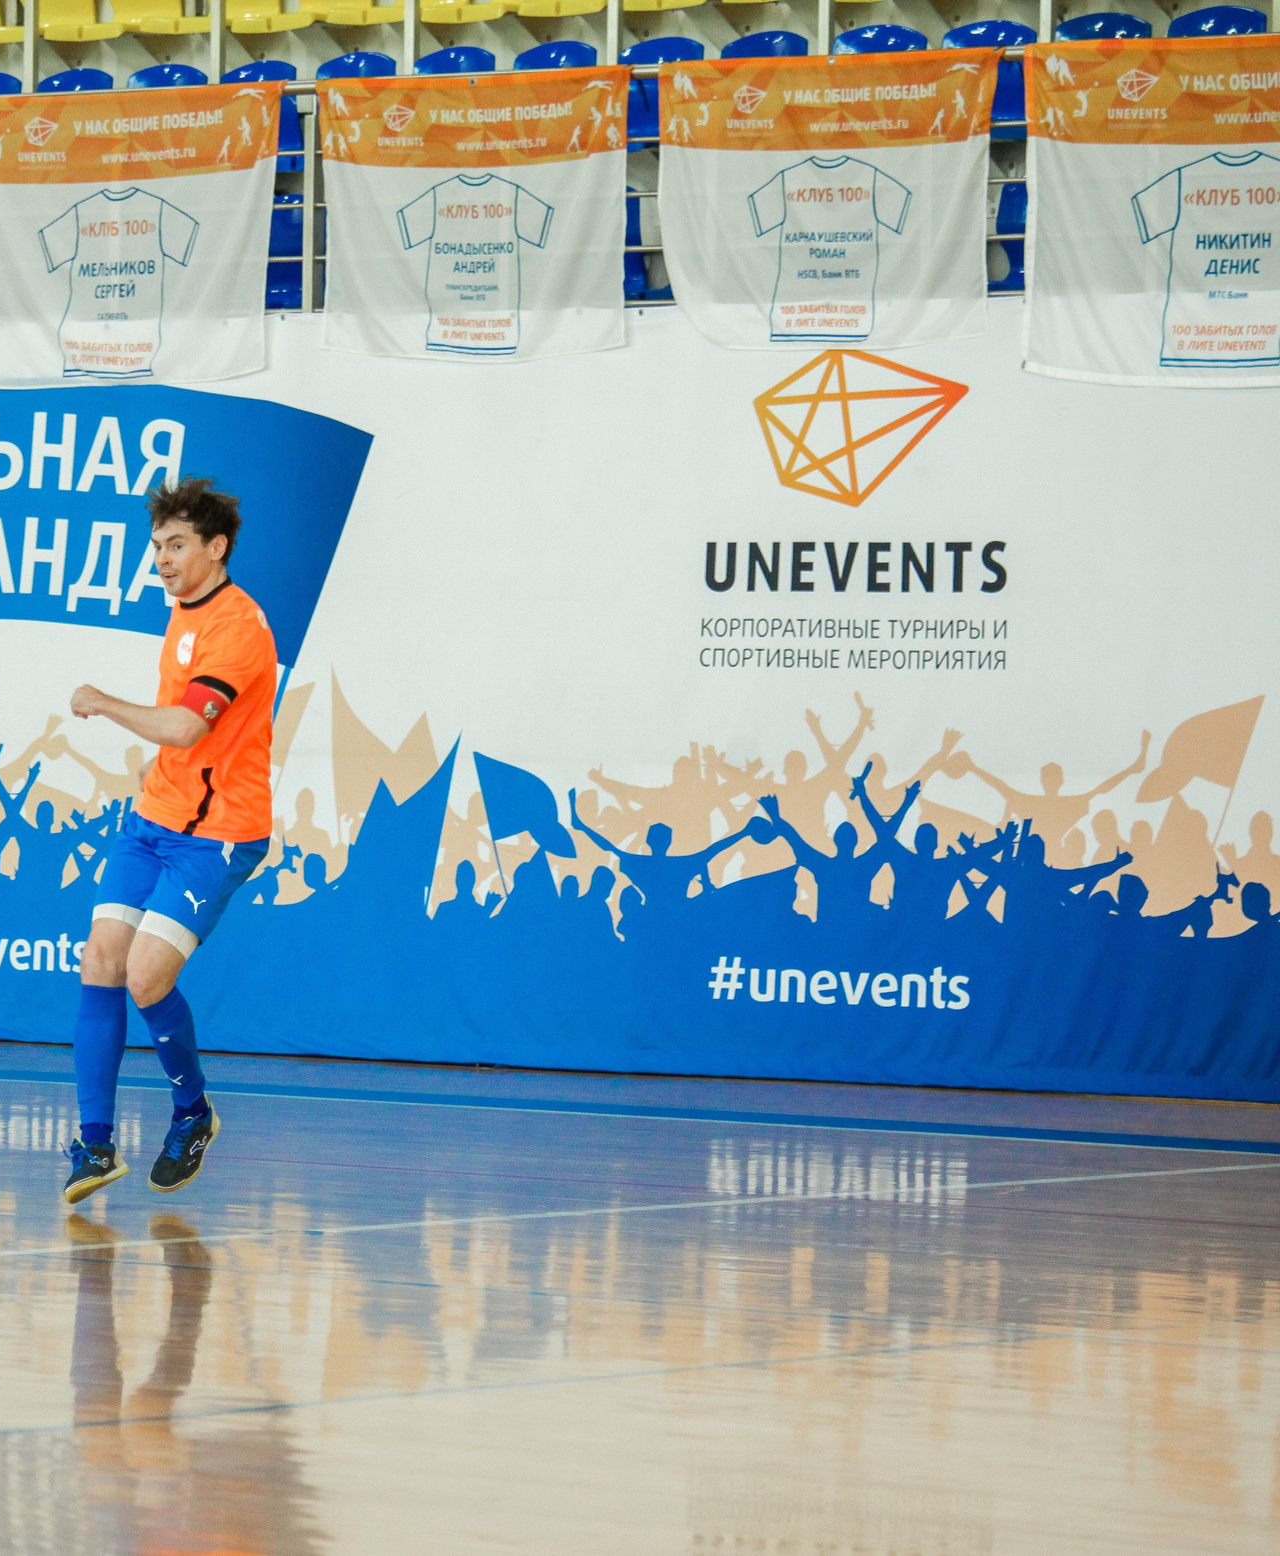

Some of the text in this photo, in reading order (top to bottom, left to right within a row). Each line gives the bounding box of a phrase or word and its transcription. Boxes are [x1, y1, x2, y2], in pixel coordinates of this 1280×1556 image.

[1179, 72, 1280, 92] У НАС ОБЩИ
[783, 82, 936, 104] У НАС ОБЩИЕ ПОБЕДЫ!
[429, 101, 573, 124] У НАС ОБЩИЕ ПОБЕДЫ!
[1107, 108, 1168, 120] UNEVENTS
[73, 109, 223, 136] У НАС ОБЩИЕ ПОБЕДЫ!
[726, 119, 775, 129] UNEVENTS
[809, 119, 909, 133] www.unevents.ru
[377, 136, 424, 147] UNEVENTS
[456, 137, 547, 151] www.unevents.ru
[17, 151, 67, 163] UNEVENTS
[101, 147, 196, 165] www.unevents.ru
[787, 187, 834, 204] «КЛУБ
[1184, 188, 1241, 207] «КЛУБ
[438, 203, 479, 219] «КЛУБ
[80, 221, 119, 238] «КЛУБ
[784, 229, 873, 243] КАРНАУШЕВСКИЙ
[434, 242, 514, 256] БОНАДЫСЕНКО
[1196, 233, 1272, 251] НИКИТИН
[809, 248, 846, 259] РОМАН
[77, 260, 156, 278] МЕЛЬНИКОВ
[453, 258, 495, 274] АНДРЕЙ
[822, 270, 842, 279] Банк
[844, 269, 860, 279] ВТБ
[1204, 258, 1260, 277] ДЕНИС
[94, 280, 136, 299] СЕРГЕЙ
[1208, 290, 1248, 300] МТС Банк
[780, 305, 867, 315] 100 ЗАБИТЫХ ГОЛОВ
[785, 318, 860, 328] В ЛИГЕ UNEVENTS
[1171, 324, 1277, 338] 100 ЗАБИТЫХ ГОЛОВ
[65, 341, 153, 353] 100 ЗАБИТЫХ ГОЛОВ
[1177, 338, 1267, 352] В ЛИГЕ UNEVENTS
[71, 354, 144, 366] В ЛИГЕ UNEVENTS
[705, 540, 1008, 593] UNEVENTS
[700, 617, 1008, 640] КОРПОРАТИВНЫЕ ТУРНИРЫ И
[699, 648, 1007, 670] СПОРТИВНЫЕ МЕРОПРИЯТИЯ
[708, 956, 970, 1010] #unevents
